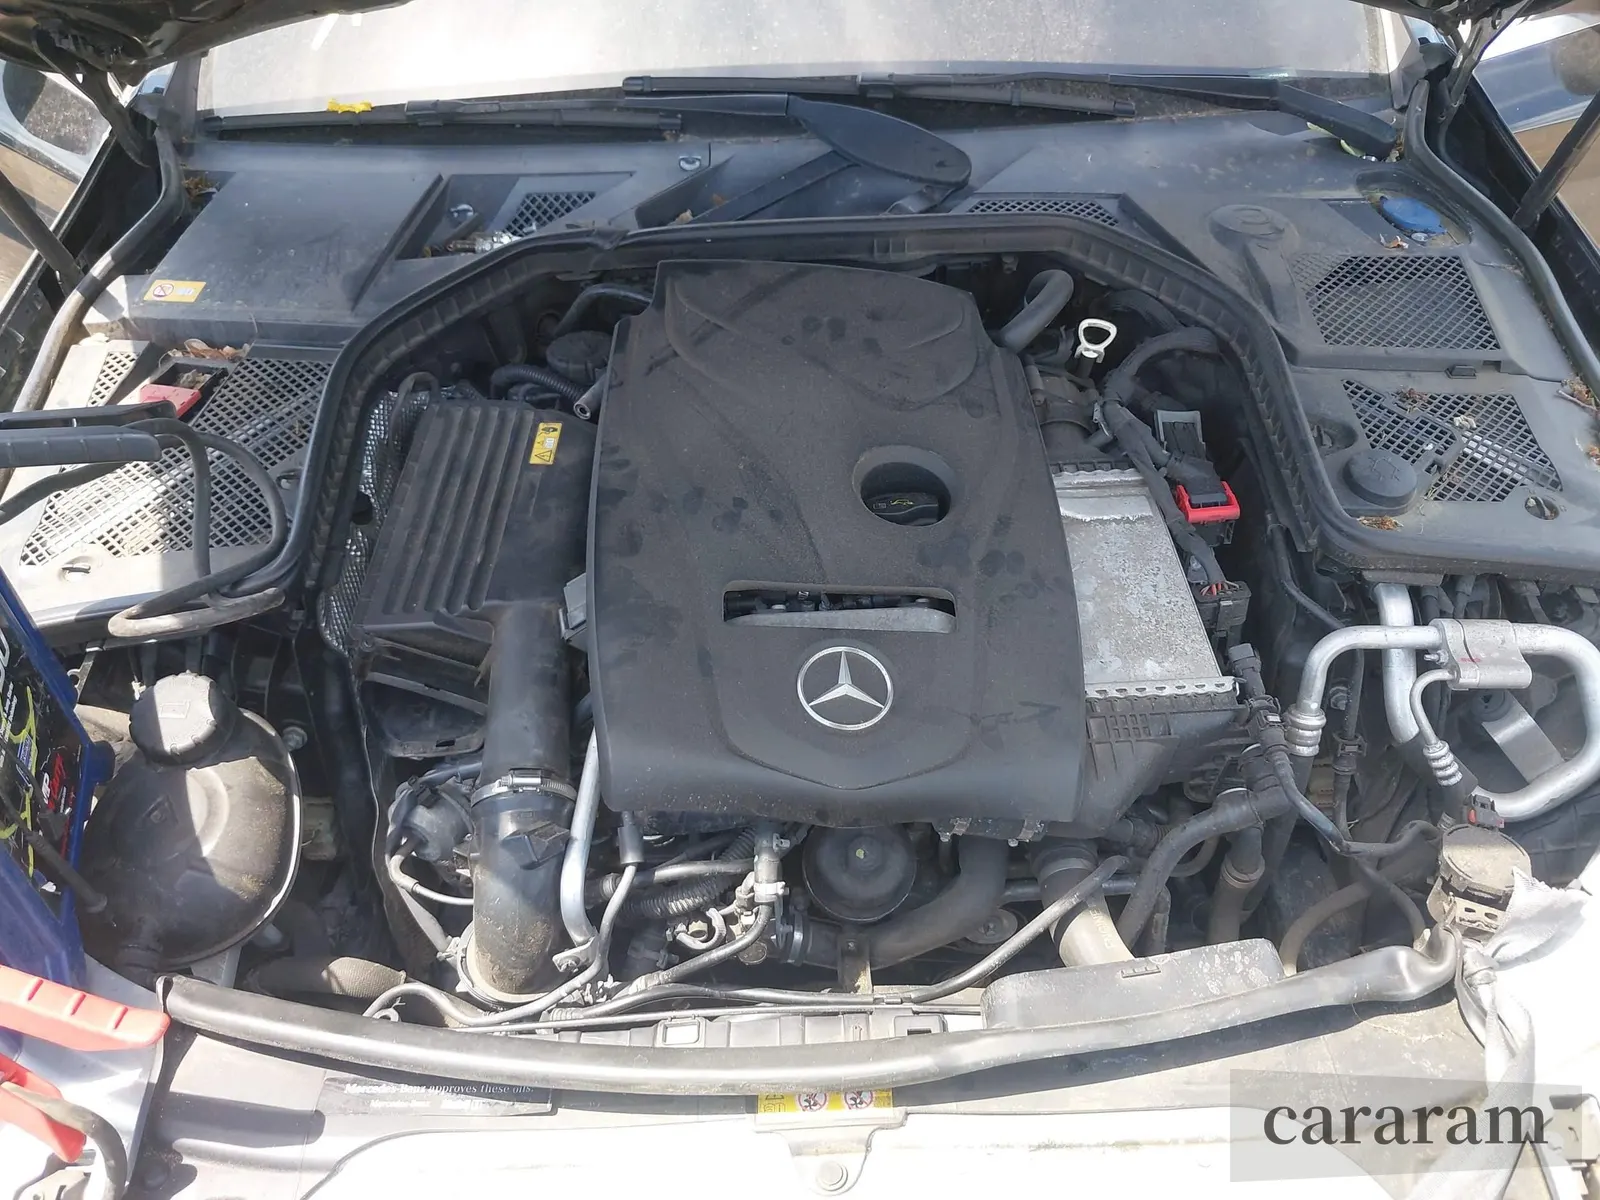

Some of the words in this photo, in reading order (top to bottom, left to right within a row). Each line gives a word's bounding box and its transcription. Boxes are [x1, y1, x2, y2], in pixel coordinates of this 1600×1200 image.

[344, 1083, 427, 1093] Mercedes-Benz
[427, 1085, 477, 1095] approves
[480, 1084, 509, 1093] these
[512, 1086, 533, 1094] oils.
